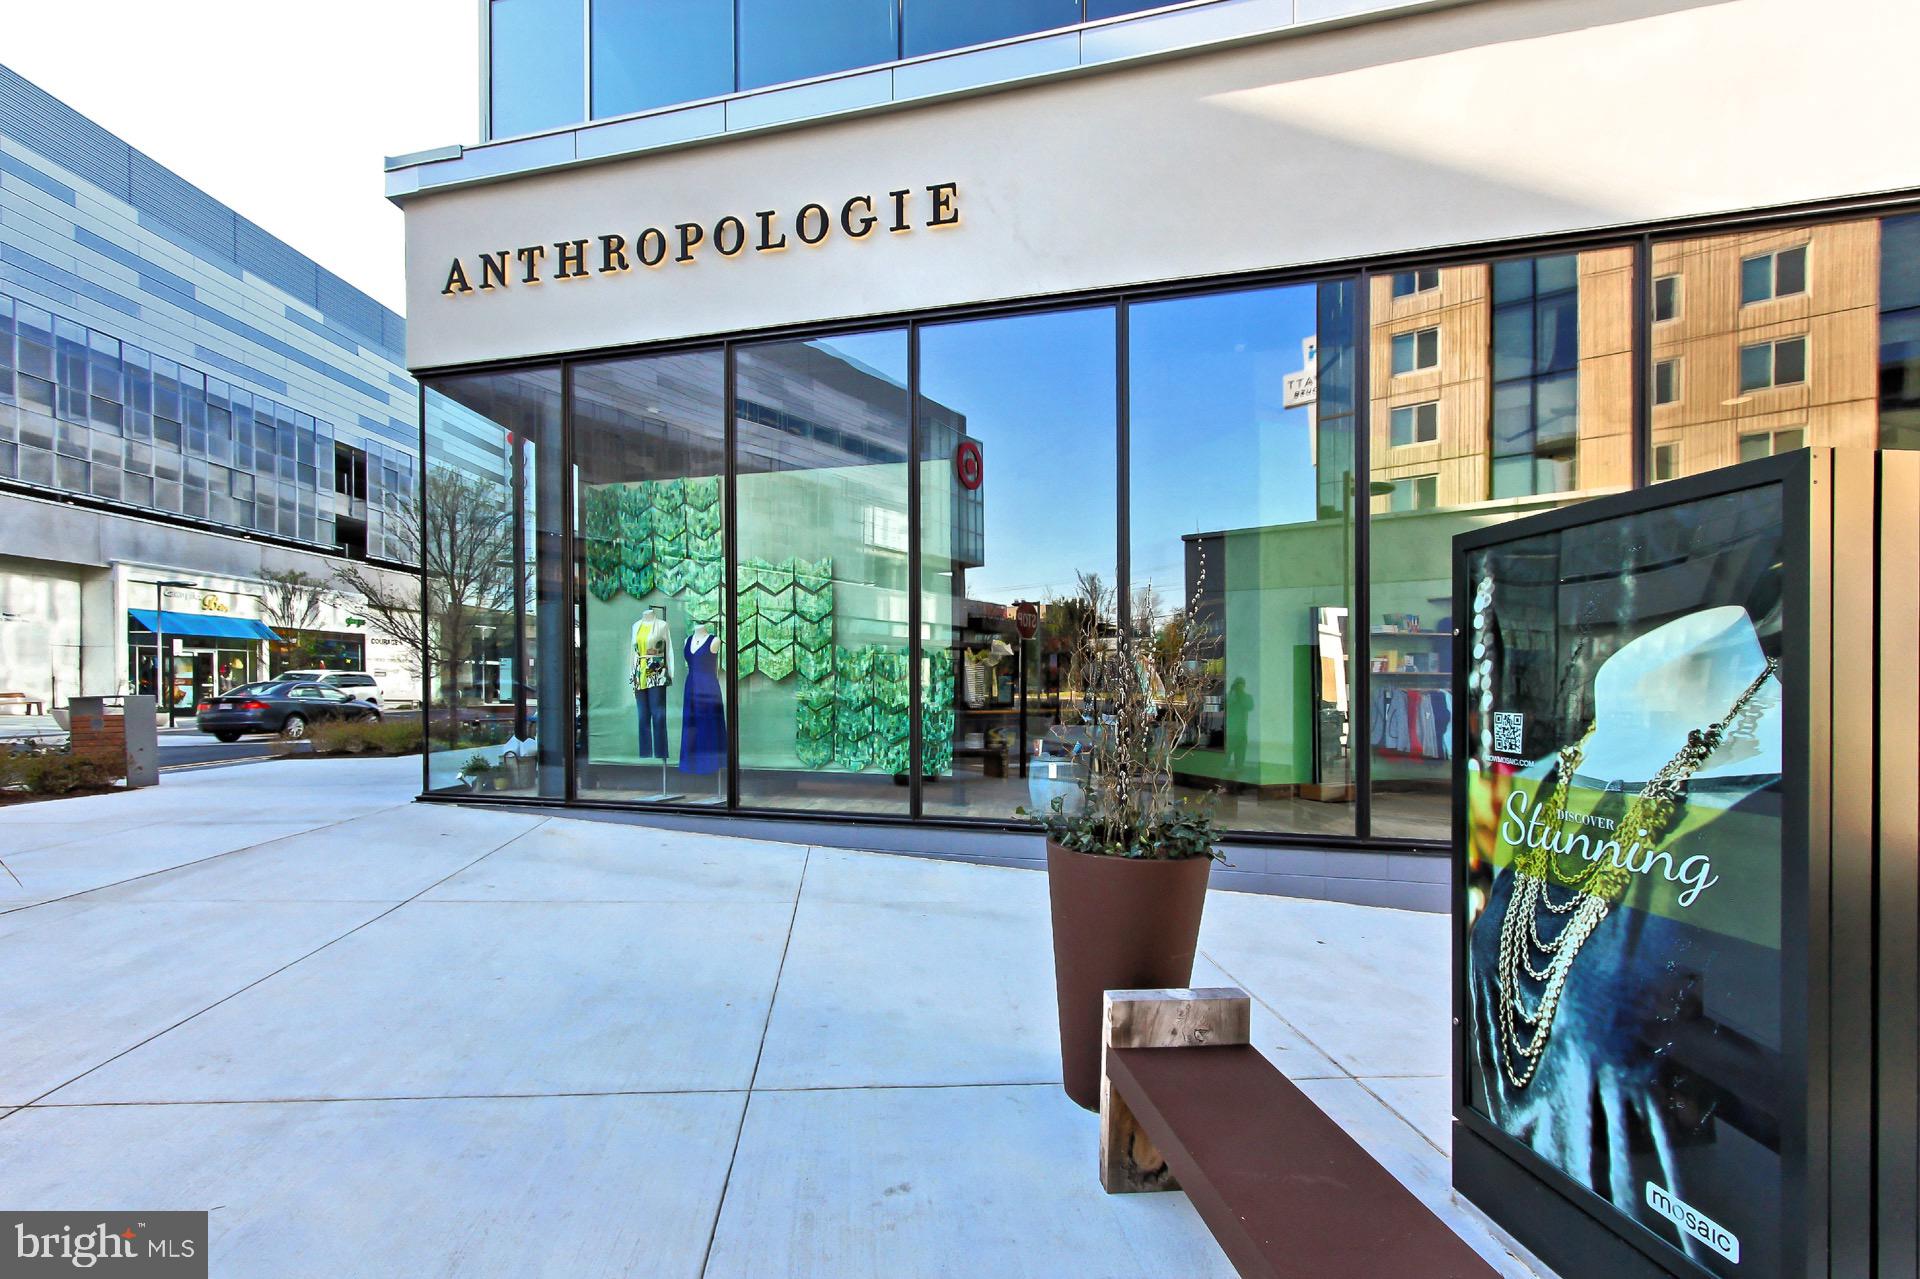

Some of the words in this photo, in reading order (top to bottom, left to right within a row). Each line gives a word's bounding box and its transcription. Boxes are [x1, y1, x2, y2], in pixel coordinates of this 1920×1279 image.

[441, 182, 960, 295] ANTHROPOLOGIE
[1502, 790, 1719, 908] Stunning
[1556, 808, 1615, 831] DISCOVER
[1652, 1189, 1731, 1252] mosaic
